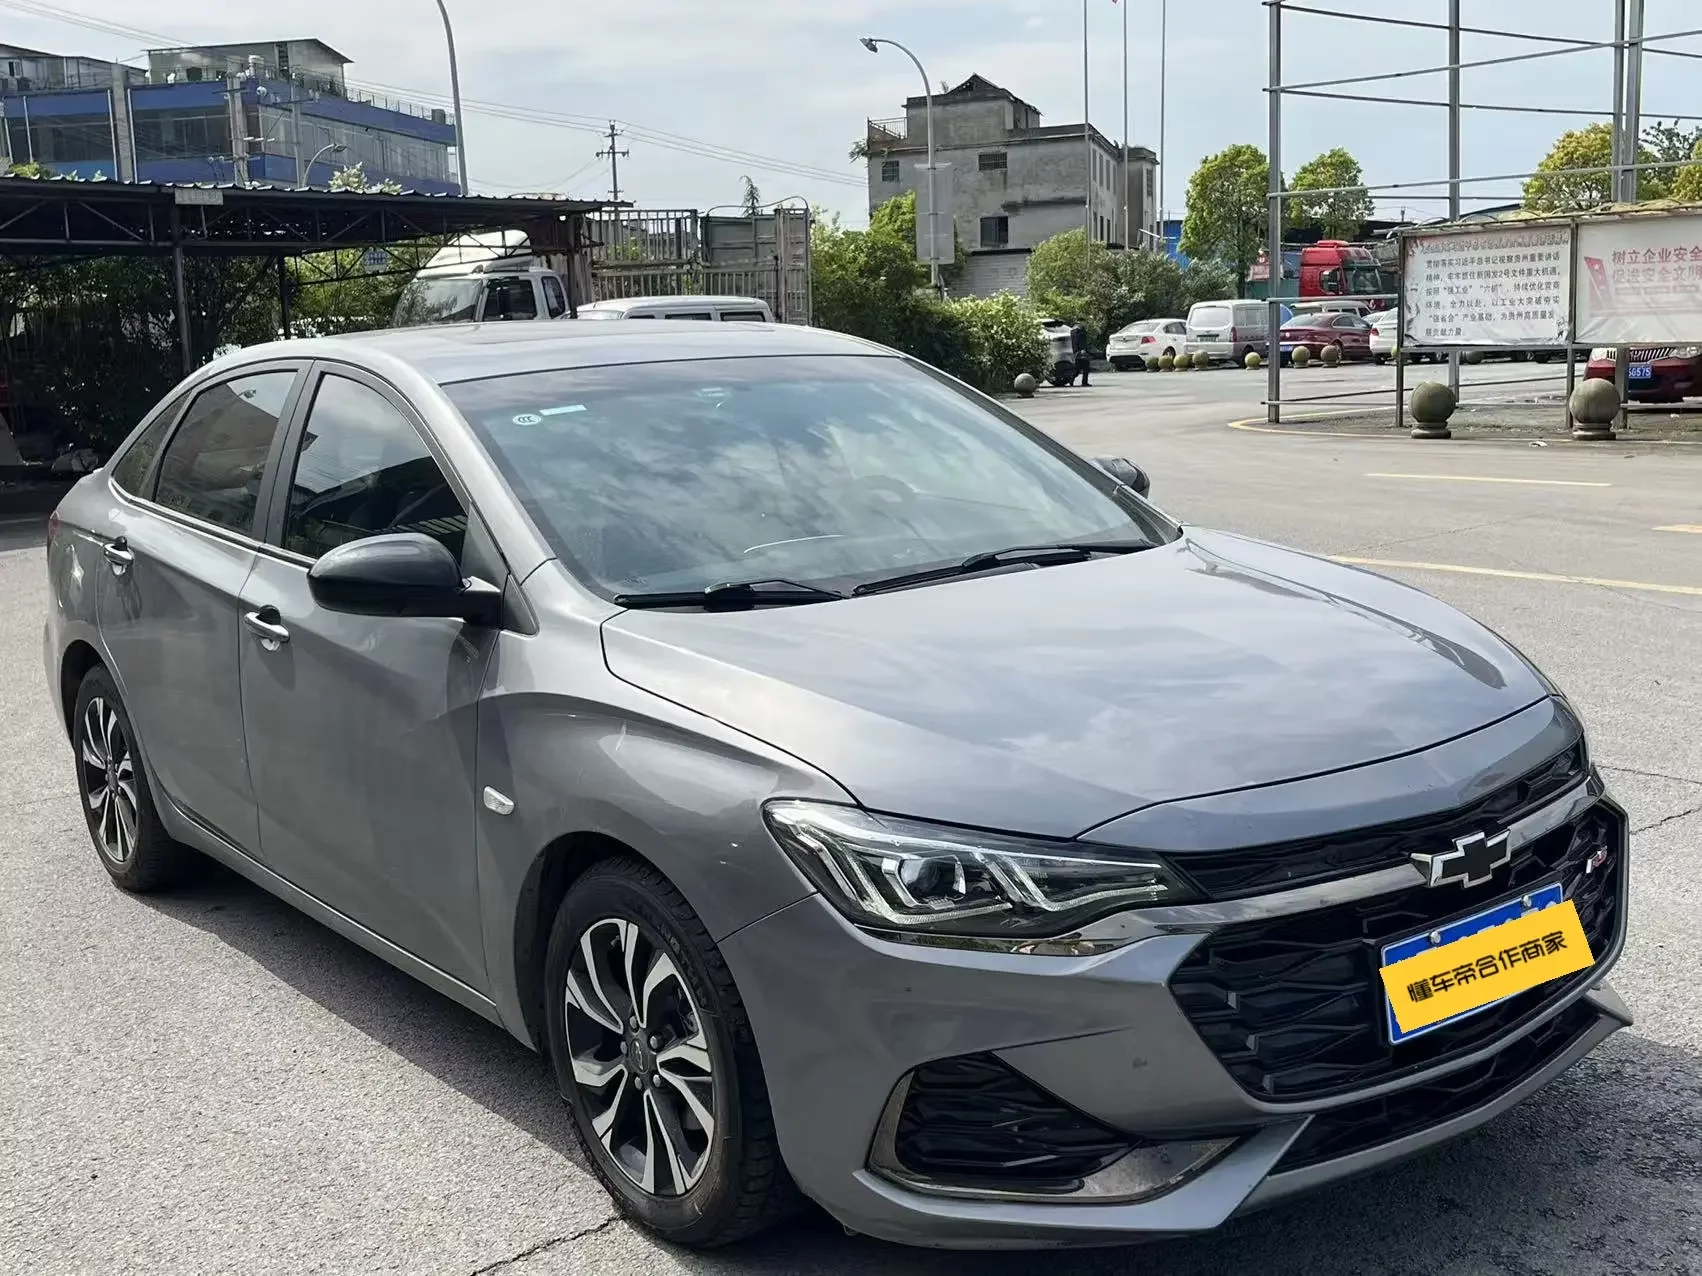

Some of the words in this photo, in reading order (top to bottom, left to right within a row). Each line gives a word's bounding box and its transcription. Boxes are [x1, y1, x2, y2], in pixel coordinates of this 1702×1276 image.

[1611, 246, 1702, 266] 树立企业安全
